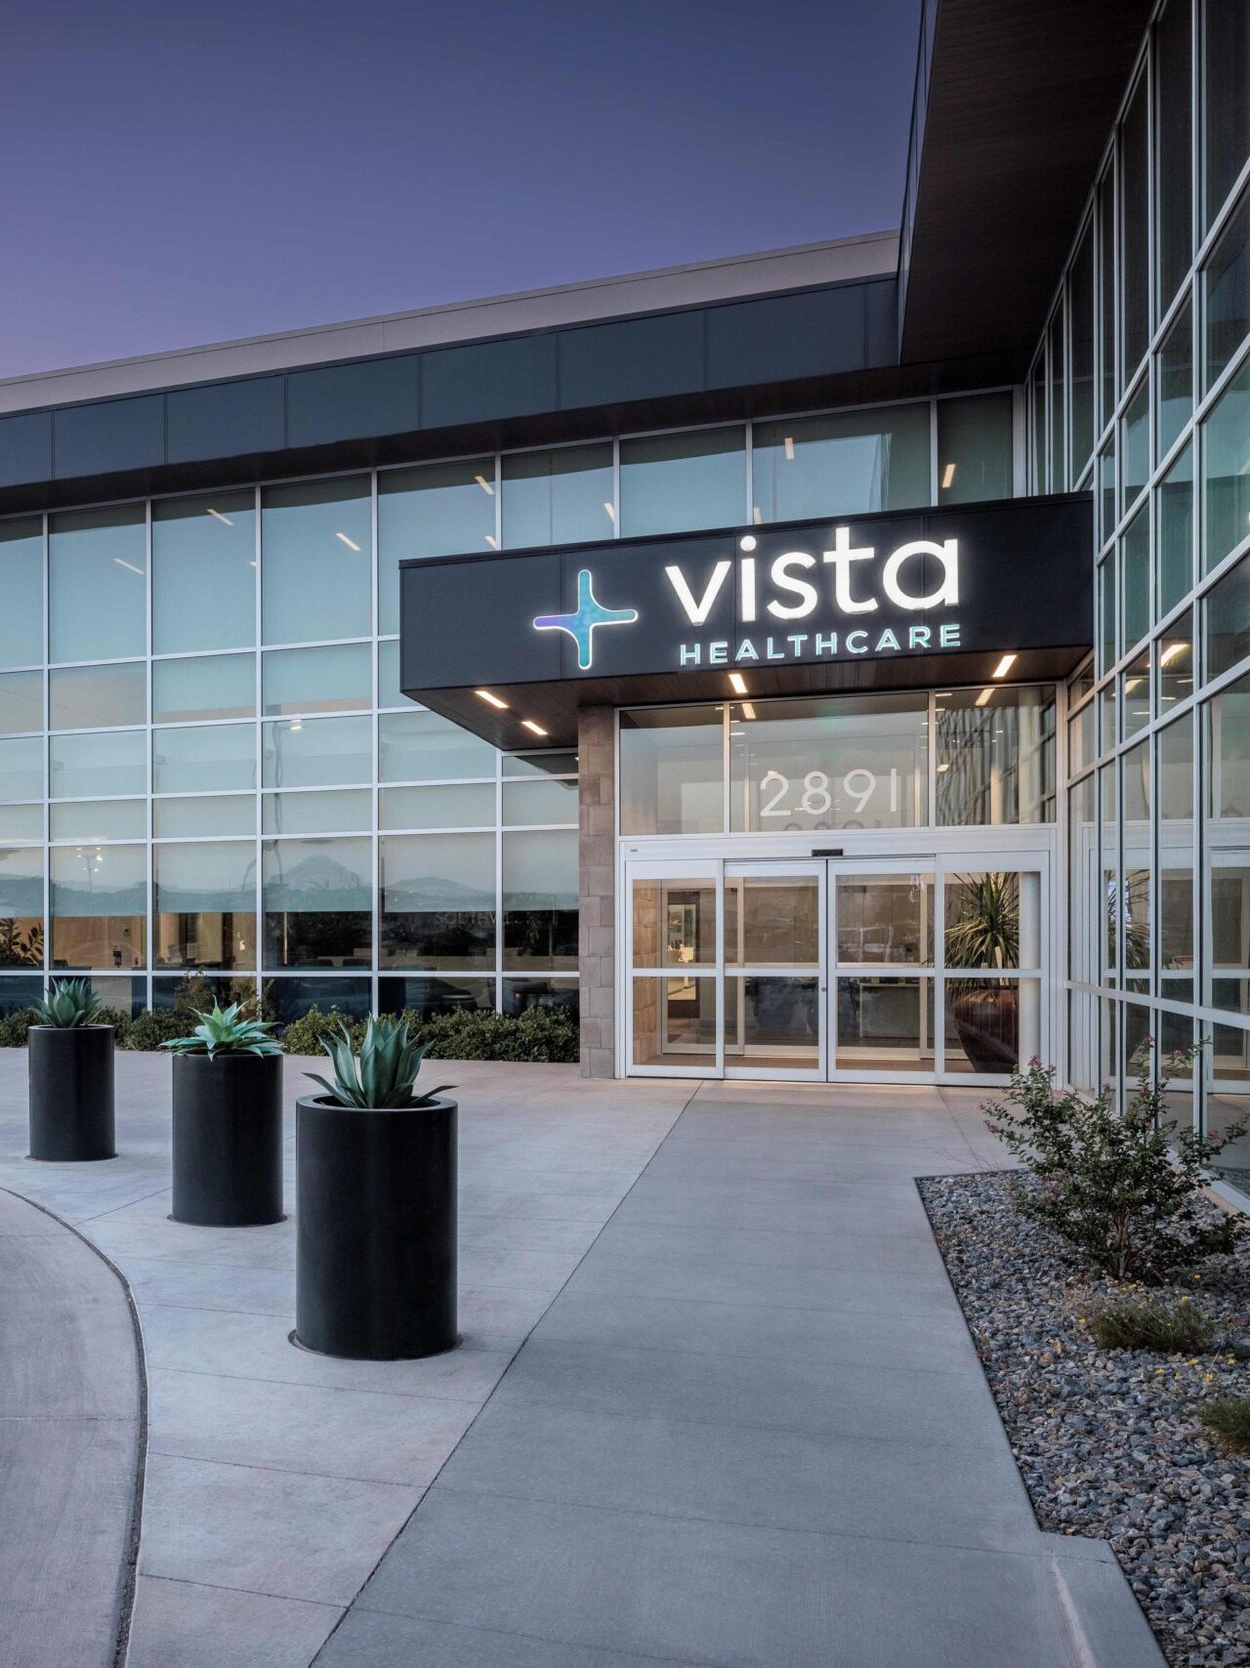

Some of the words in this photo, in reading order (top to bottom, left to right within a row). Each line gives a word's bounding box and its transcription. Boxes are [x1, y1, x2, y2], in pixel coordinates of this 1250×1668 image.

[665, 527, 959, 625] vista
[680, 624, 961, 666] HEALTHCARE
[760, 768, 897, 816] 2891
